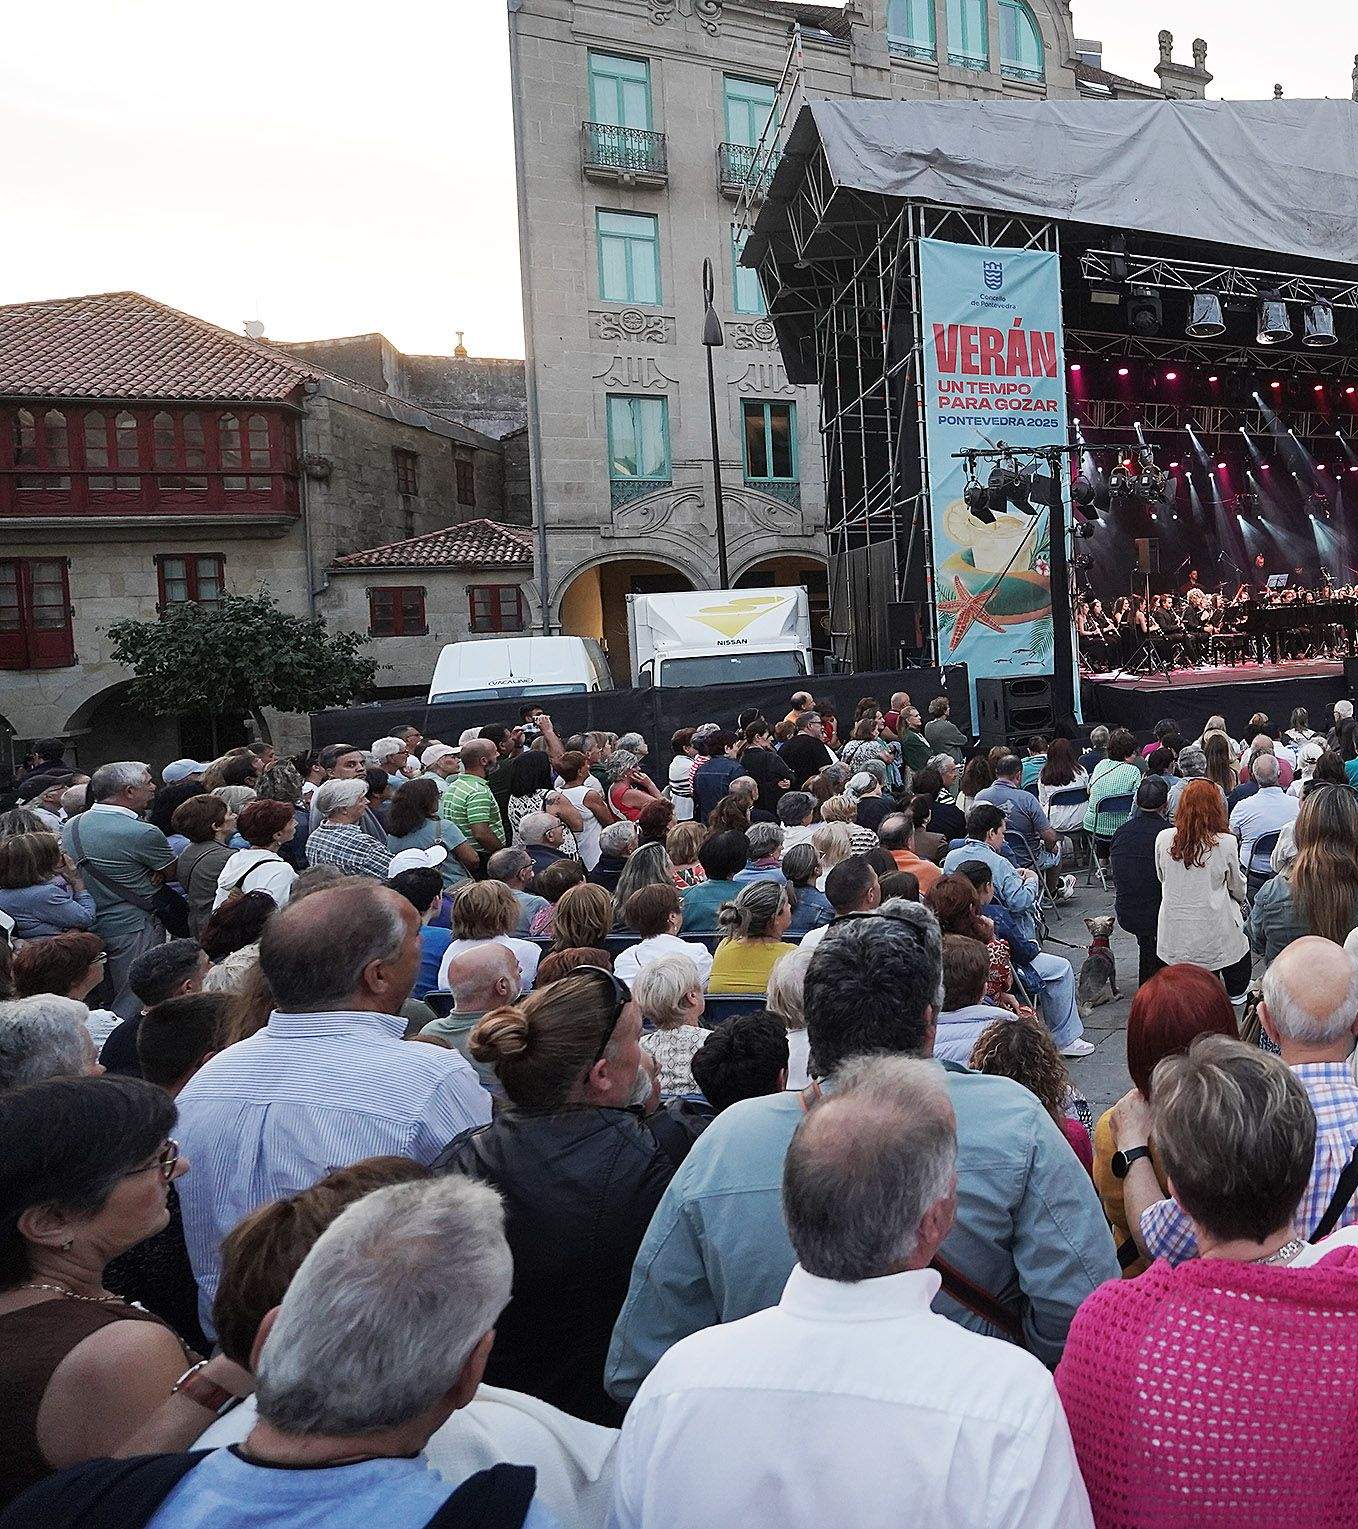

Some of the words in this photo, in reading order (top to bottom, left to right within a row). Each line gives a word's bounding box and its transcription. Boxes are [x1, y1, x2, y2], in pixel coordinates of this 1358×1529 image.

[980, 293, 1006, 302] Concello
[980, 301, 1017, 310] Pontevedra
[932, 317, 1057, 377] VERÁN
[938, 380, 964, 393] UN
[966, 381, 1032, 395] TEMPO
[938, 396, 993, 410] PARA
[994, 398, 1058, 412] GOZAR
[938, 416, 1026, 427] PONTEVEDRA
[1026, 418, 1059, 428] 2025
[717, 638, 748, 646] NISSAN
